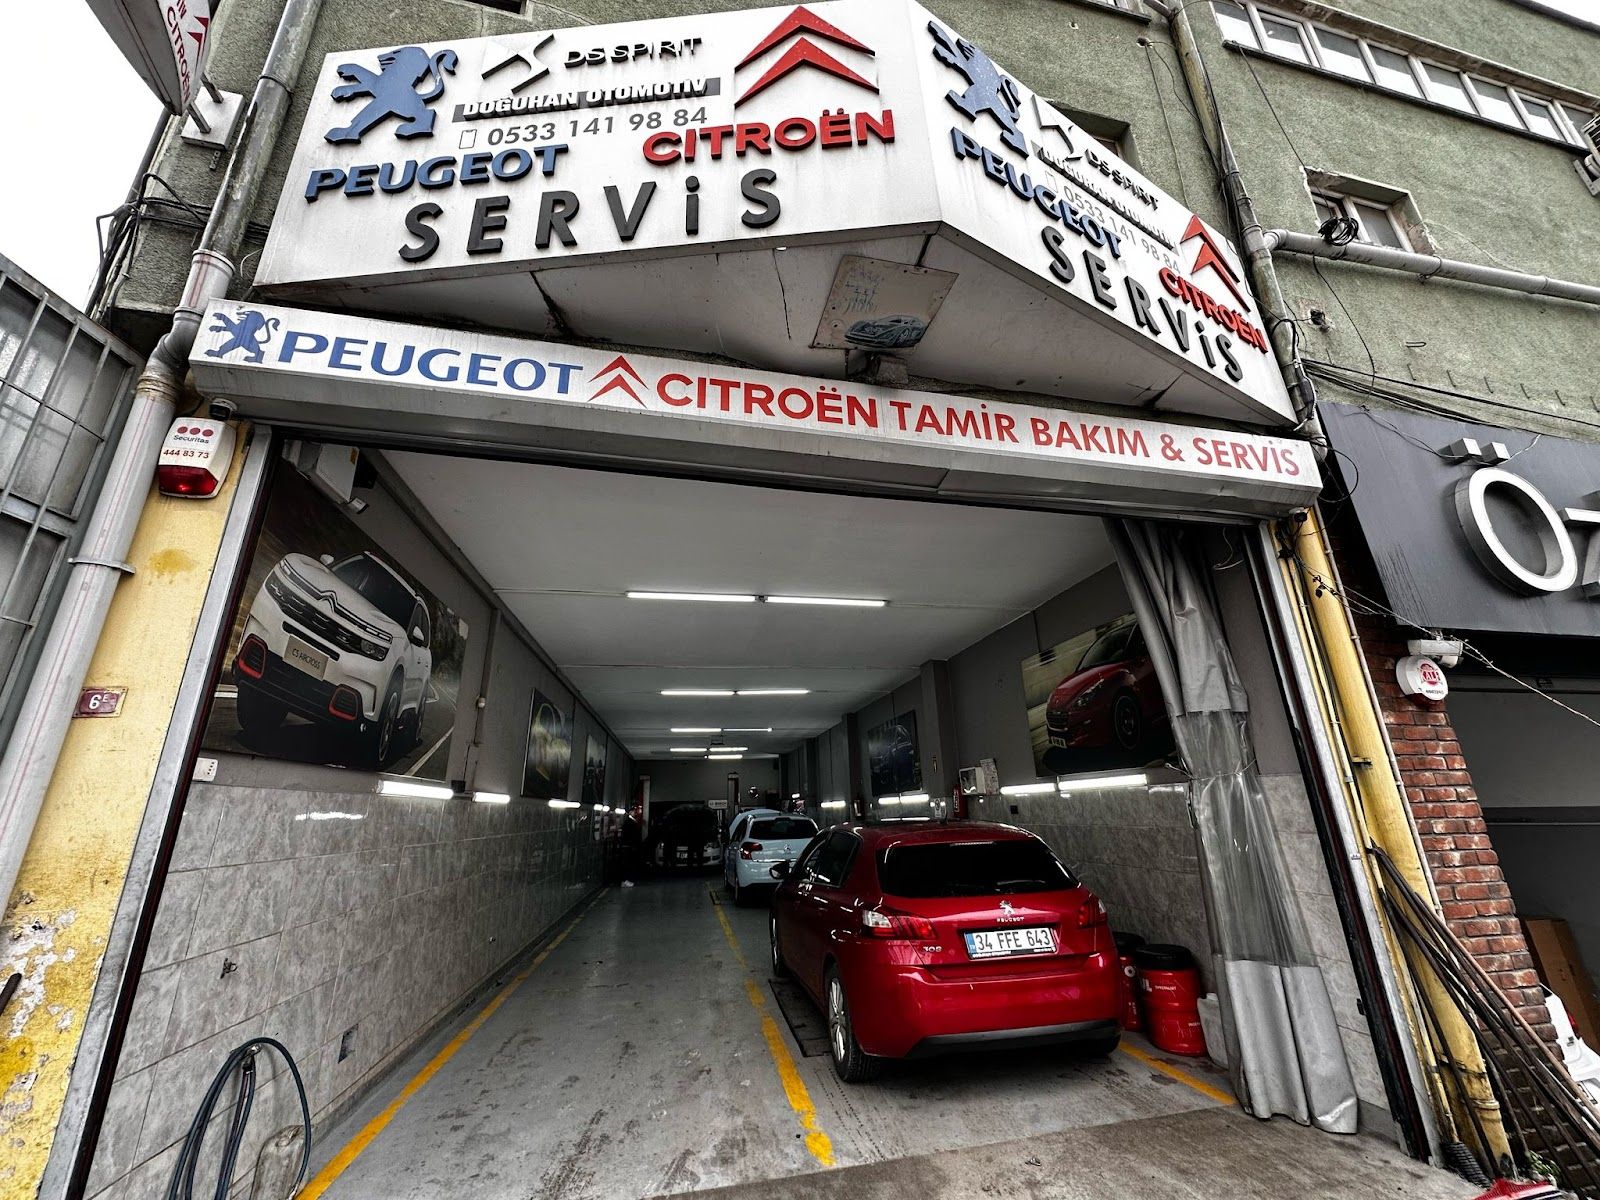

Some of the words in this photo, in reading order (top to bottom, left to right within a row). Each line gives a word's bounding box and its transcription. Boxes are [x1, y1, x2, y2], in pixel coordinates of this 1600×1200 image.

[487, 122, 556, 146] 0533
[569, 116, 614, 137] 141
[629, 111, 662, 131] 98
[673, 106, 707, 126] 84
[643, 108, 895, 166] CITROËN
[304, 143, 569, 203] PEUGEOT
[950, 126, 1122, 260] PEUGEOT
[1064, 185, 1105, 224] 0533
[1109, 215, 1137, 246] 141
[1141, 238, 1160, 261] 98
[1163, 253, 1181, 275] 84
[1158, 267, 1268, 353] CITROËN
[278, 331, 583, 394] PEUGEOT
[656, 373, 878, 429] CITROËN
[1030, 417, 1150, 458] BAKIM
[1160, 433, 1185, 462] &
[173, 434, 209, 444] Securitas
[182, 450, 195, 458] 83
[197, 451, 209, 459] 73
[975, 934, 993, 951] 34
[996, 931, 1022, 949] FFE
[1026, 929, 1050, 947] 643
